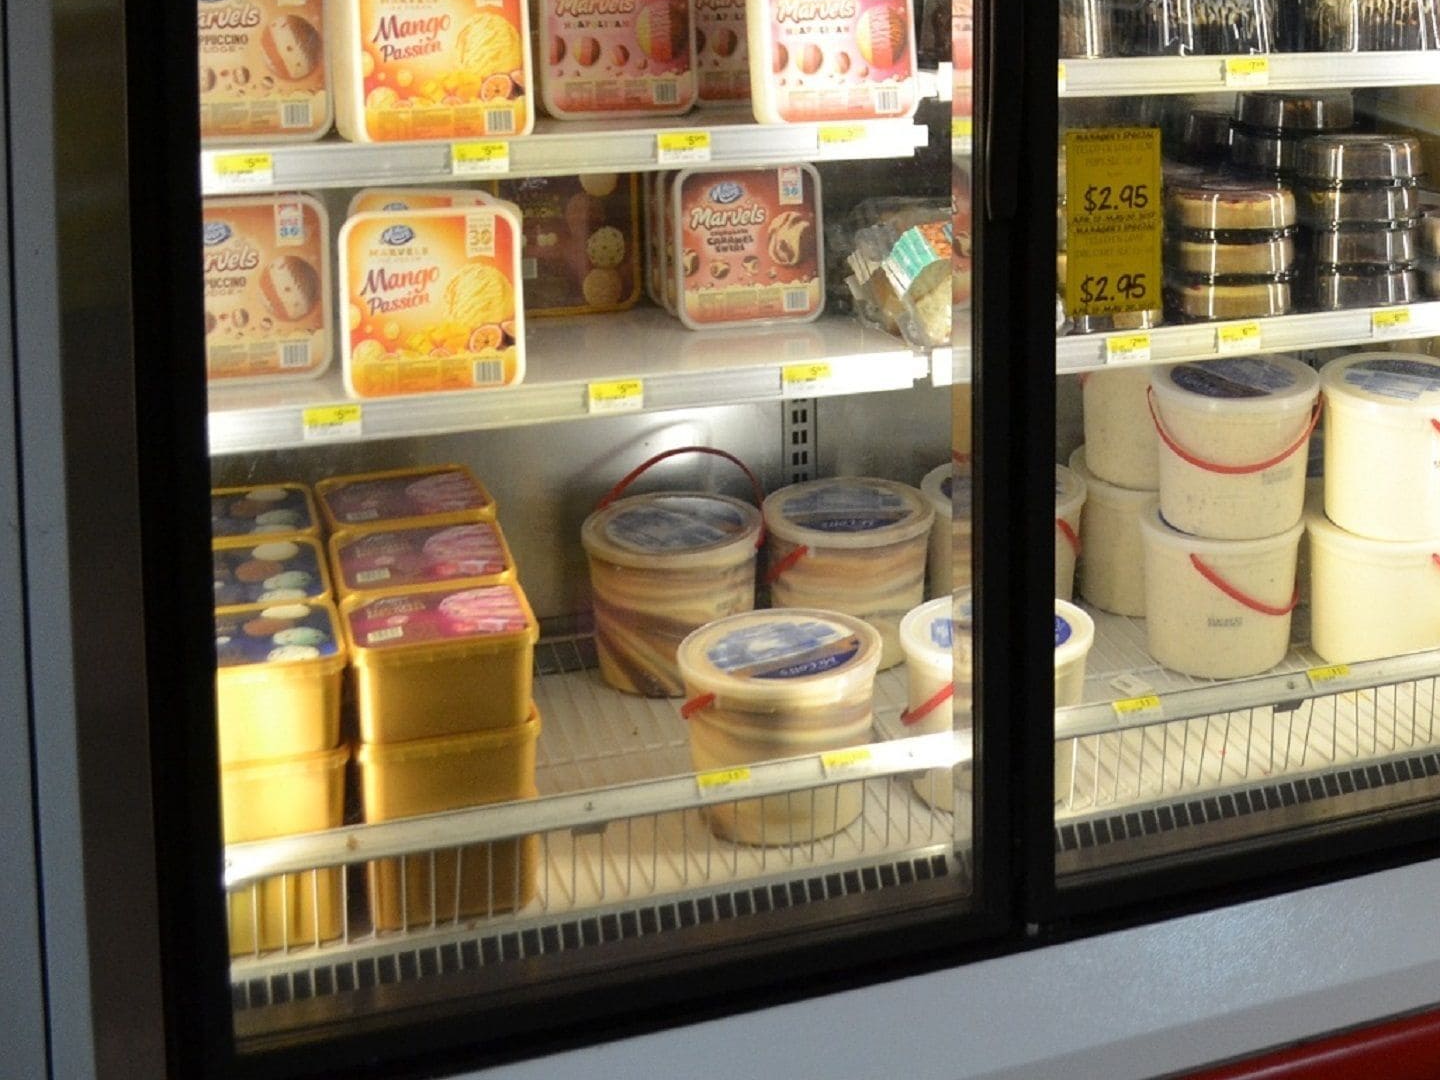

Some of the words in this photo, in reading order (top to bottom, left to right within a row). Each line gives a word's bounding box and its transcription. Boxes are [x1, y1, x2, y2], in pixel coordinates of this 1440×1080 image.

[198, 6, 261, 29] arvels
[373, 12, 452, 44] Mango
[199, 33, 249, 47] PPUCCINO
[380, 38, 443, 64] Passion
[1083, 184, 1149, 214] $2.95
[689, 205, 768, 231] Marvels
[707, 235, 754, 246] CARAMEL
[206, 246, 260, 271] rvels
[360, 265, 440, 296] Mango
[1080, 273, 1146, 307] $2.95
[367, 291, 432, 317] Passion
